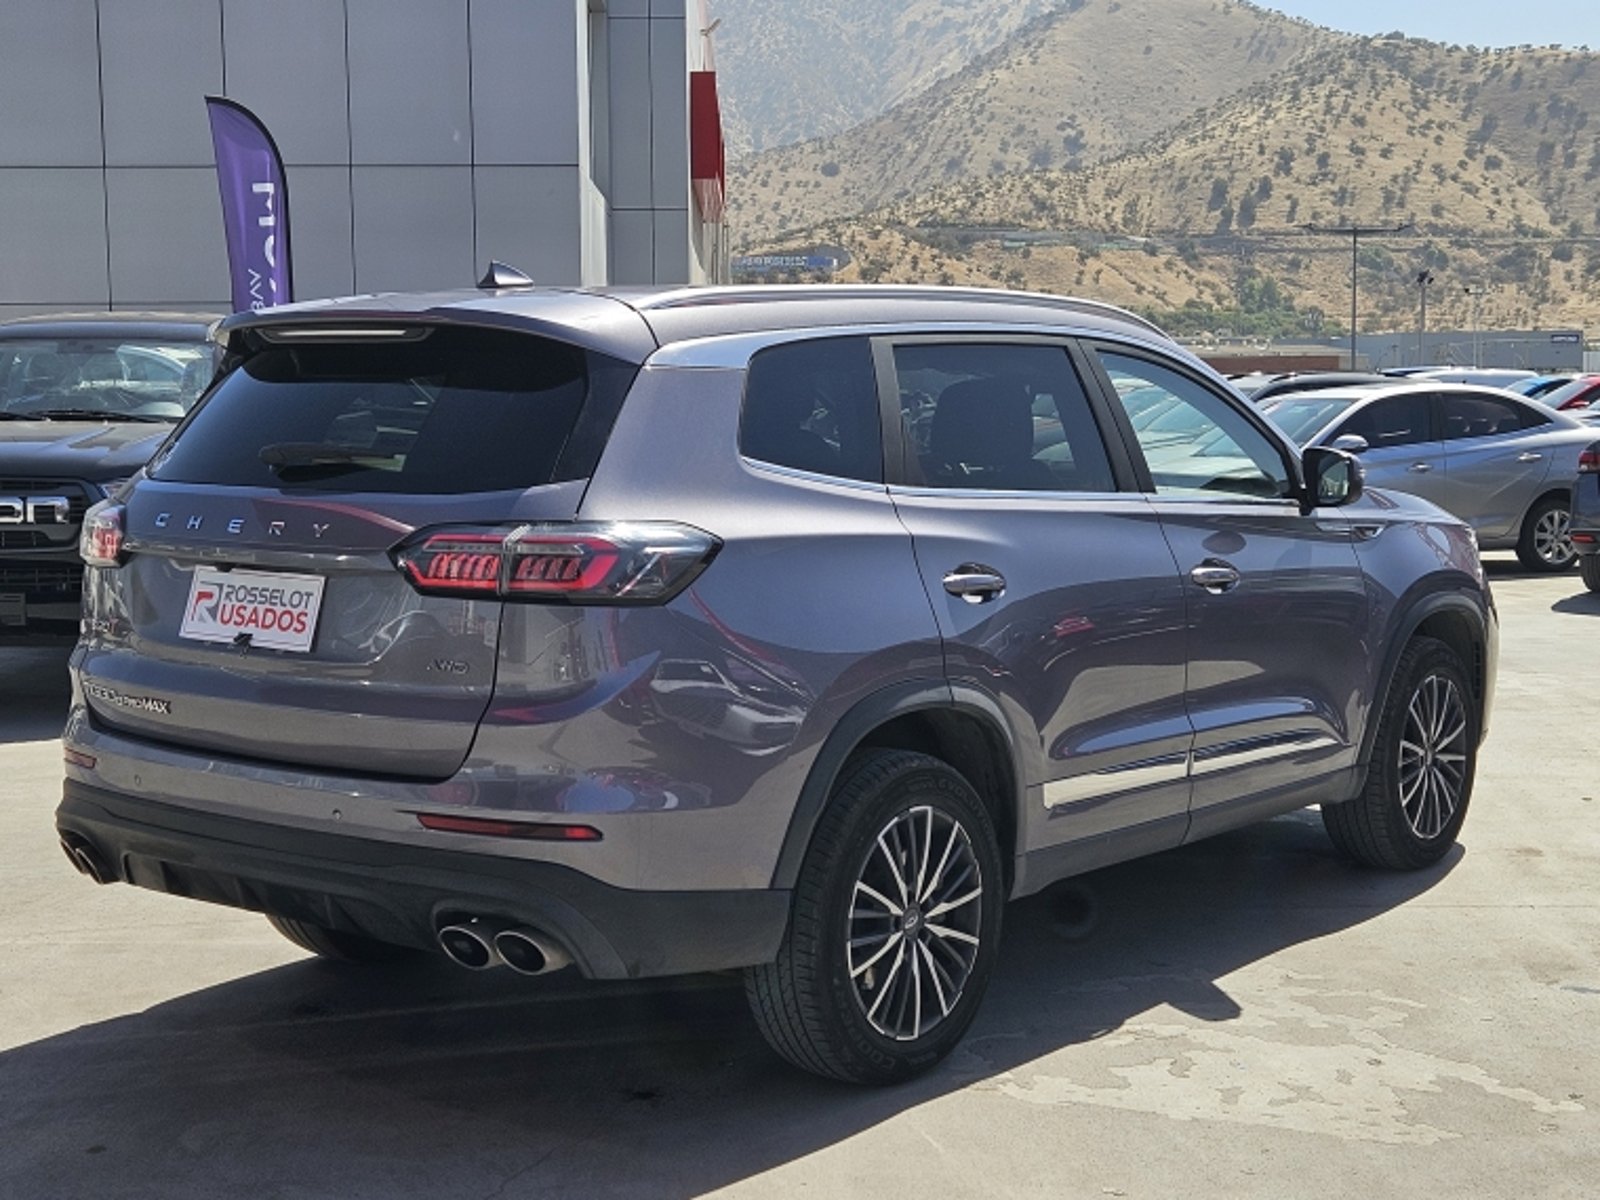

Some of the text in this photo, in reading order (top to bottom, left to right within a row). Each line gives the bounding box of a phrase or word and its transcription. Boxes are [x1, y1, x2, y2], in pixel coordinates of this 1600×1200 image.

[155, 513, 330, 538] CHERY
[223, 584, 315, 609] ROSSELOT
[219, 603, 309, 633] USADOS
